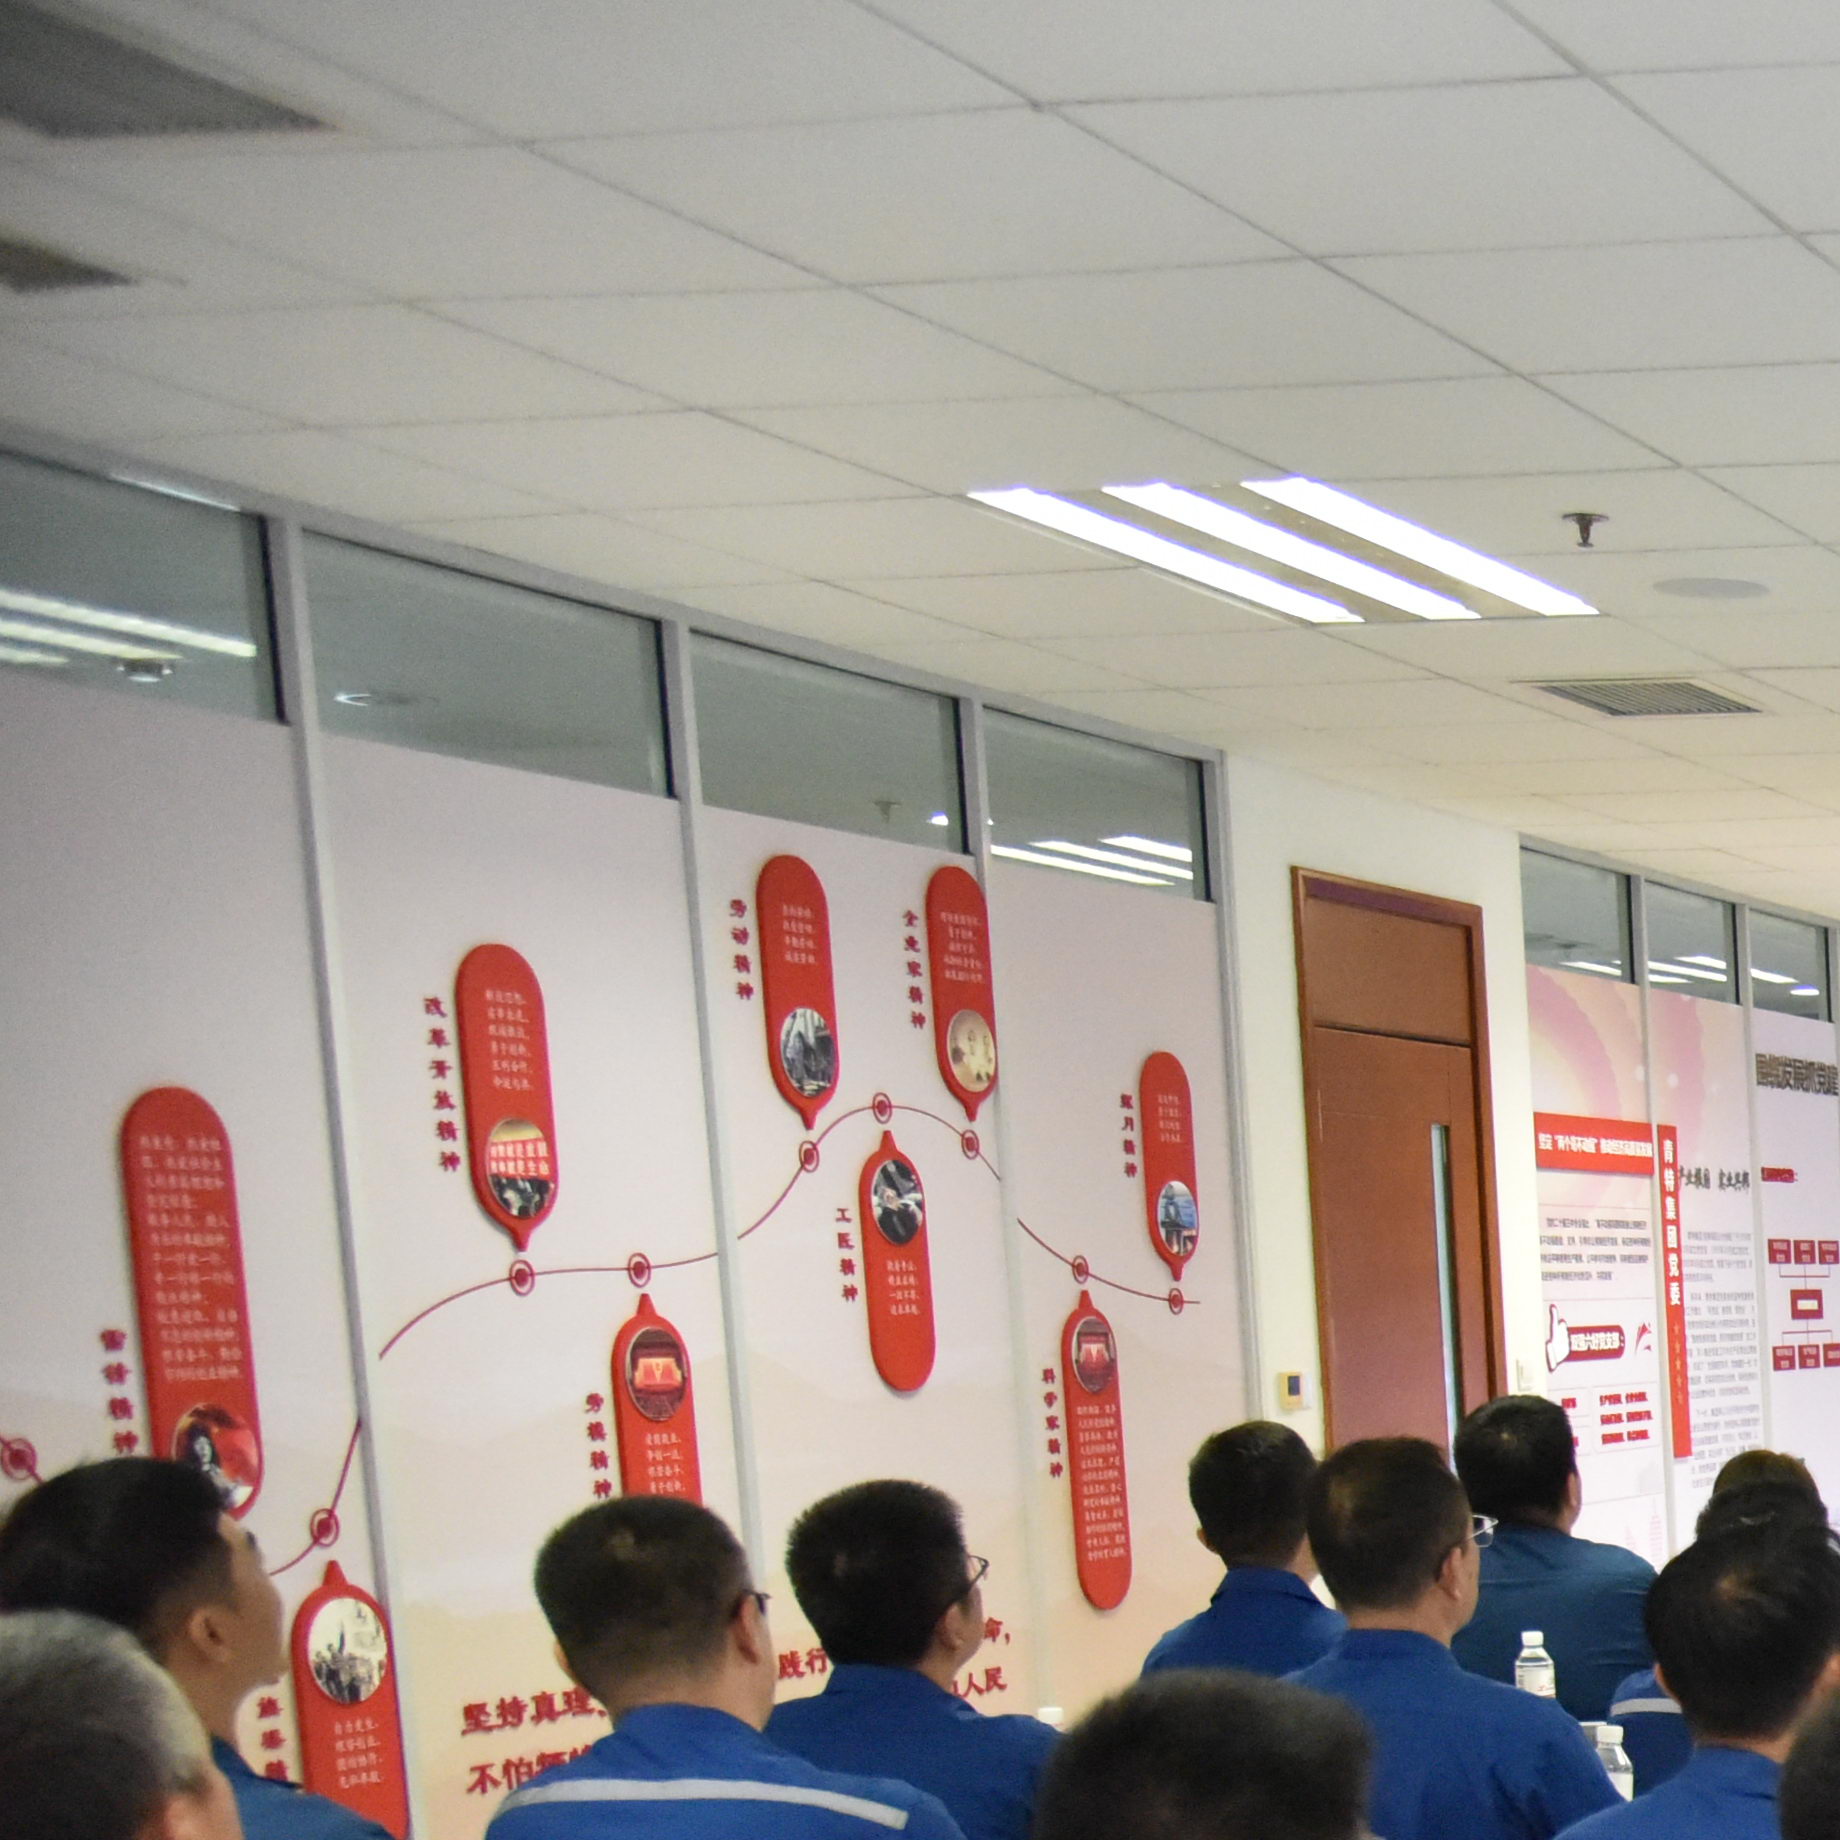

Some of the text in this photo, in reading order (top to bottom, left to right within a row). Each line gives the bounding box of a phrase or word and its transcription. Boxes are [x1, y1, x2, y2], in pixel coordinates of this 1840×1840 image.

[729, 898, 754, 1000] 劳动精神
[423, 996, 461, 1172] 改革开放精神
[835, 1207, 858, 1303] 工匠精神
[1663, 1139, 1681, 1306] 青特集团党委
[585, 1392, 613, 1499] 劳模精神
[1041, 1367, 1063, 1479] 科学家精神
[460, 1684, 608, 1736] 坚持真理、
[778, 1646, 829, 1681] 践行
[952, 1666, 1008, 1700] 人民
